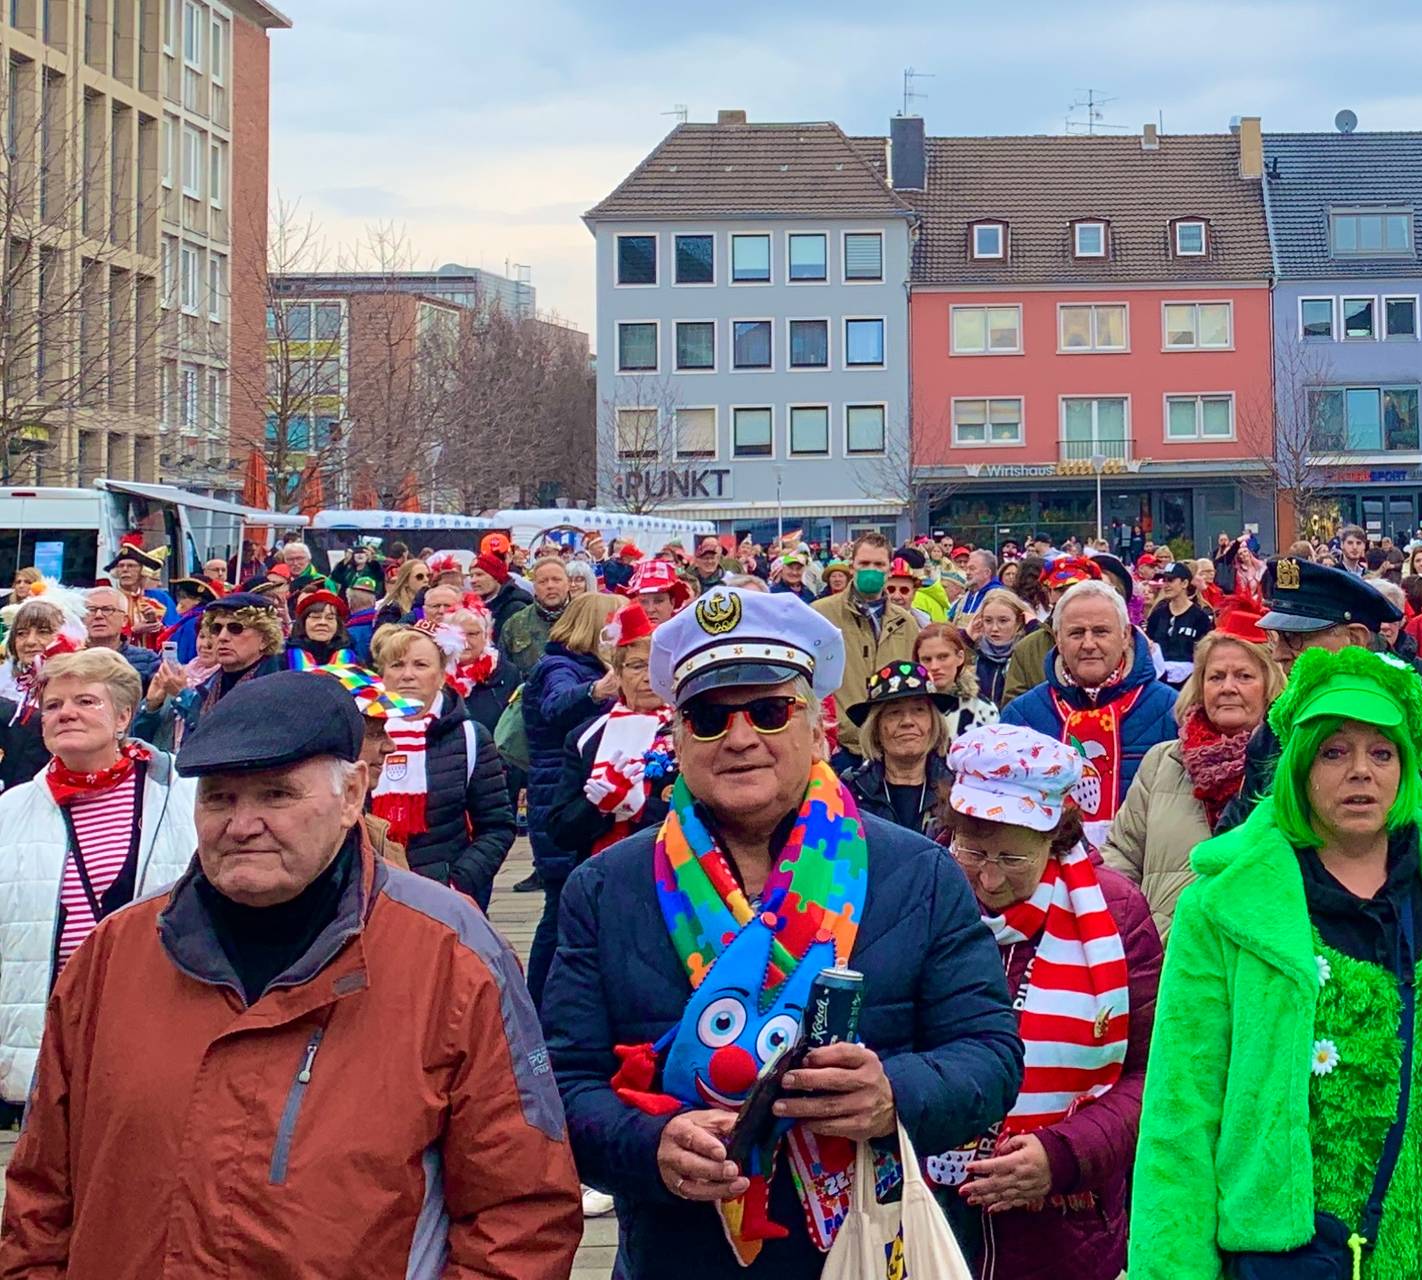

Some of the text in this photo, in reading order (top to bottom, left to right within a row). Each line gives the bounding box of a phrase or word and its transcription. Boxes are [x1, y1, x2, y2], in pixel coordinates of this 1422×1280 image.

[986, 464, 1054, 477] Wirtshaus
[614, 468, 731, 499] iPUNKT
[1178, 626, 1197, 638] FBI
